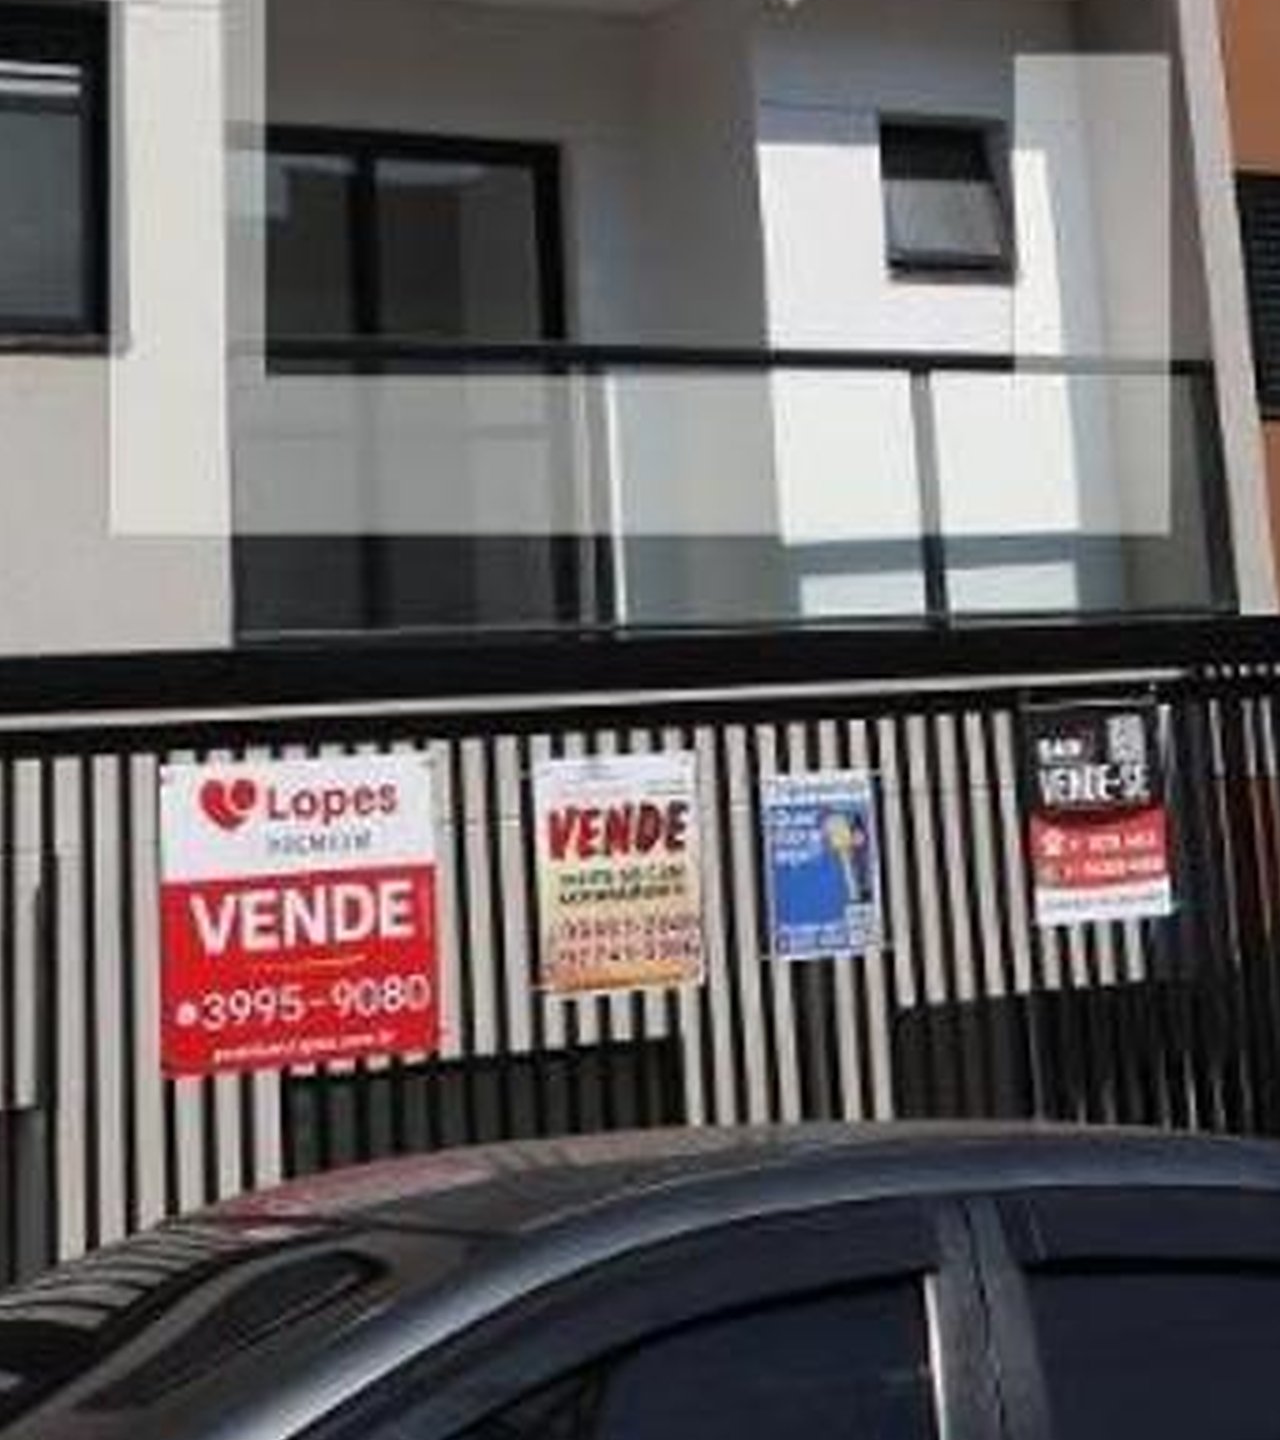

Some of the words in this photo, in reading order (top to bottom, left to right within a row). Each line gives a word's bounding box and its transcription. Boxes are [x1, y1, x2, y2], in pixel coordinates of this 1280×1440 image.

[268, 783, 398, 824] Lopes
[548, 800, 690, 861] VENDE
[189, 880, 416, 956] VENDE
[200, 973, 431, 1031] 3995-9080
